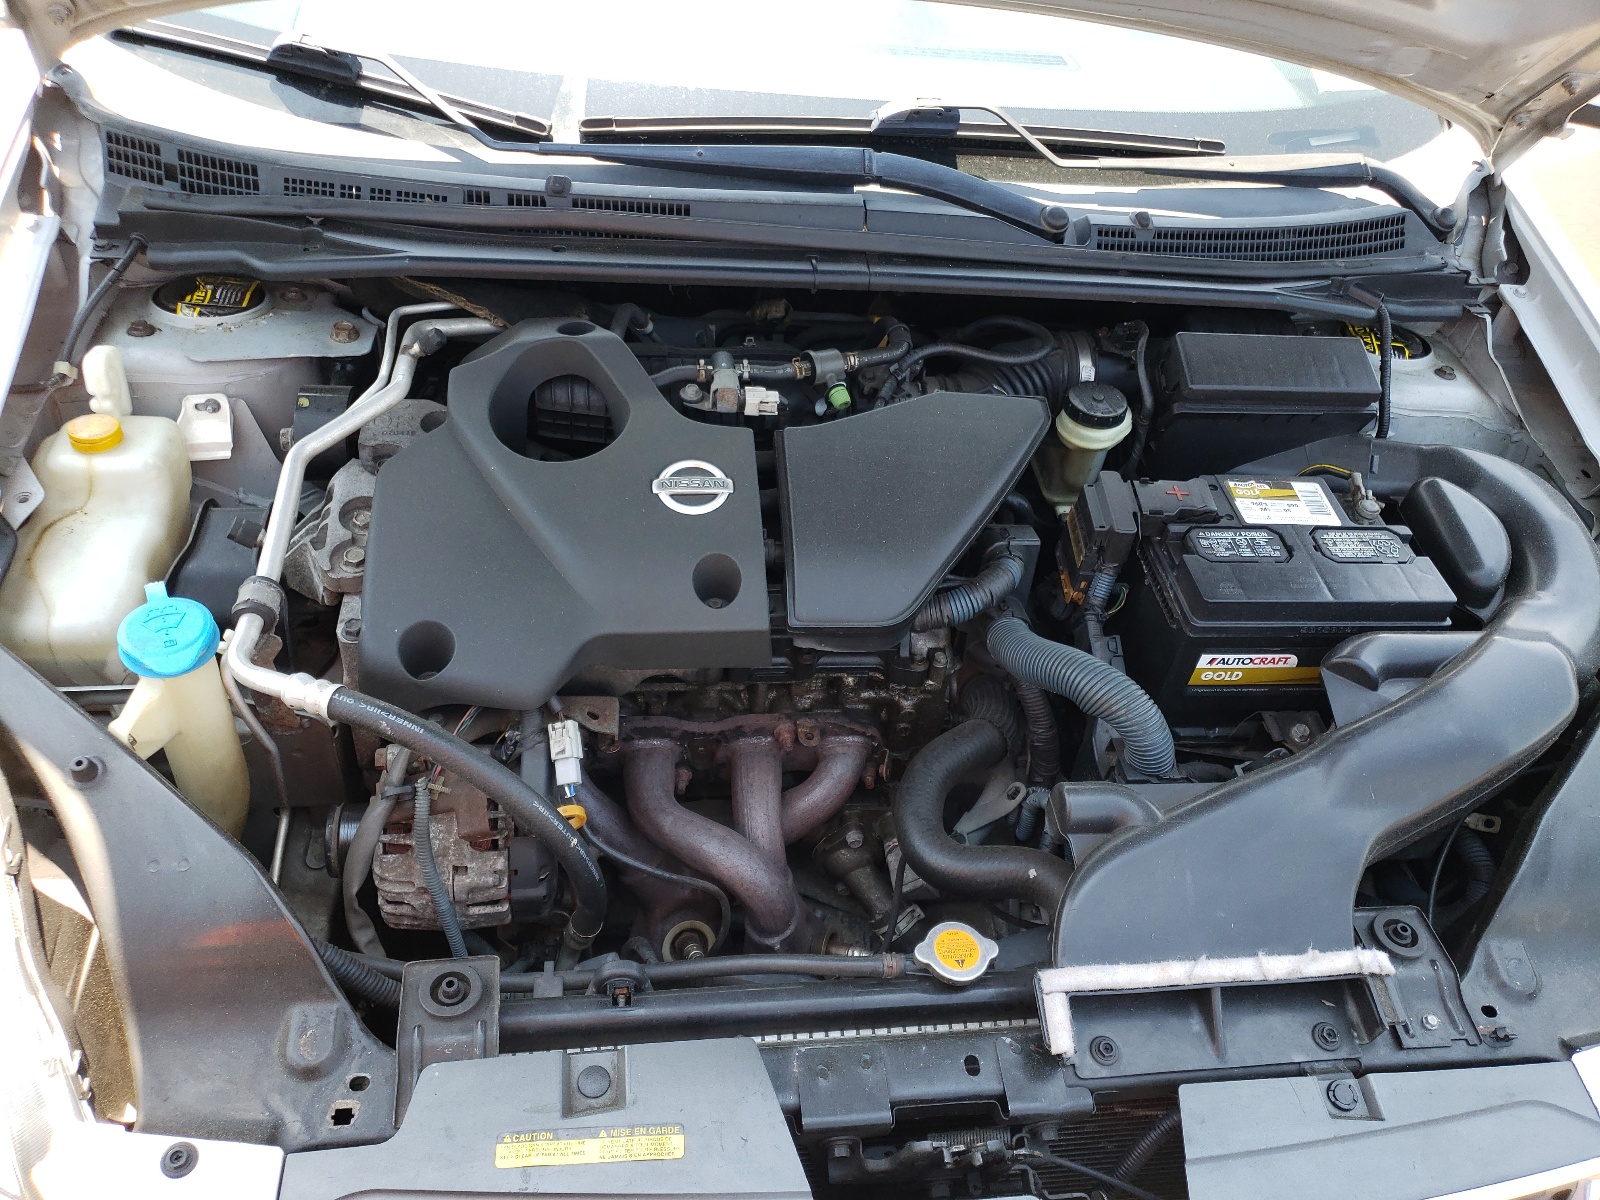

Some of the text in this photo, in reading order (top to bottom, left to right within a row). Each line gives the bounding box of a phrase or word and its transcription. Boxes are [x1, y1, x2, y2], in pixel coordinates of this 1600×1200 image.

[660, 479, 725, 489] NISSAN
[1215, 656, 1292, 666] AUTOCRAFT
[1200, 671, 1243, 681] GOLD
[610, 1126, 680, 1137] MISE EN GARDE
[513, 1132, 553, 1142] CAUTION
